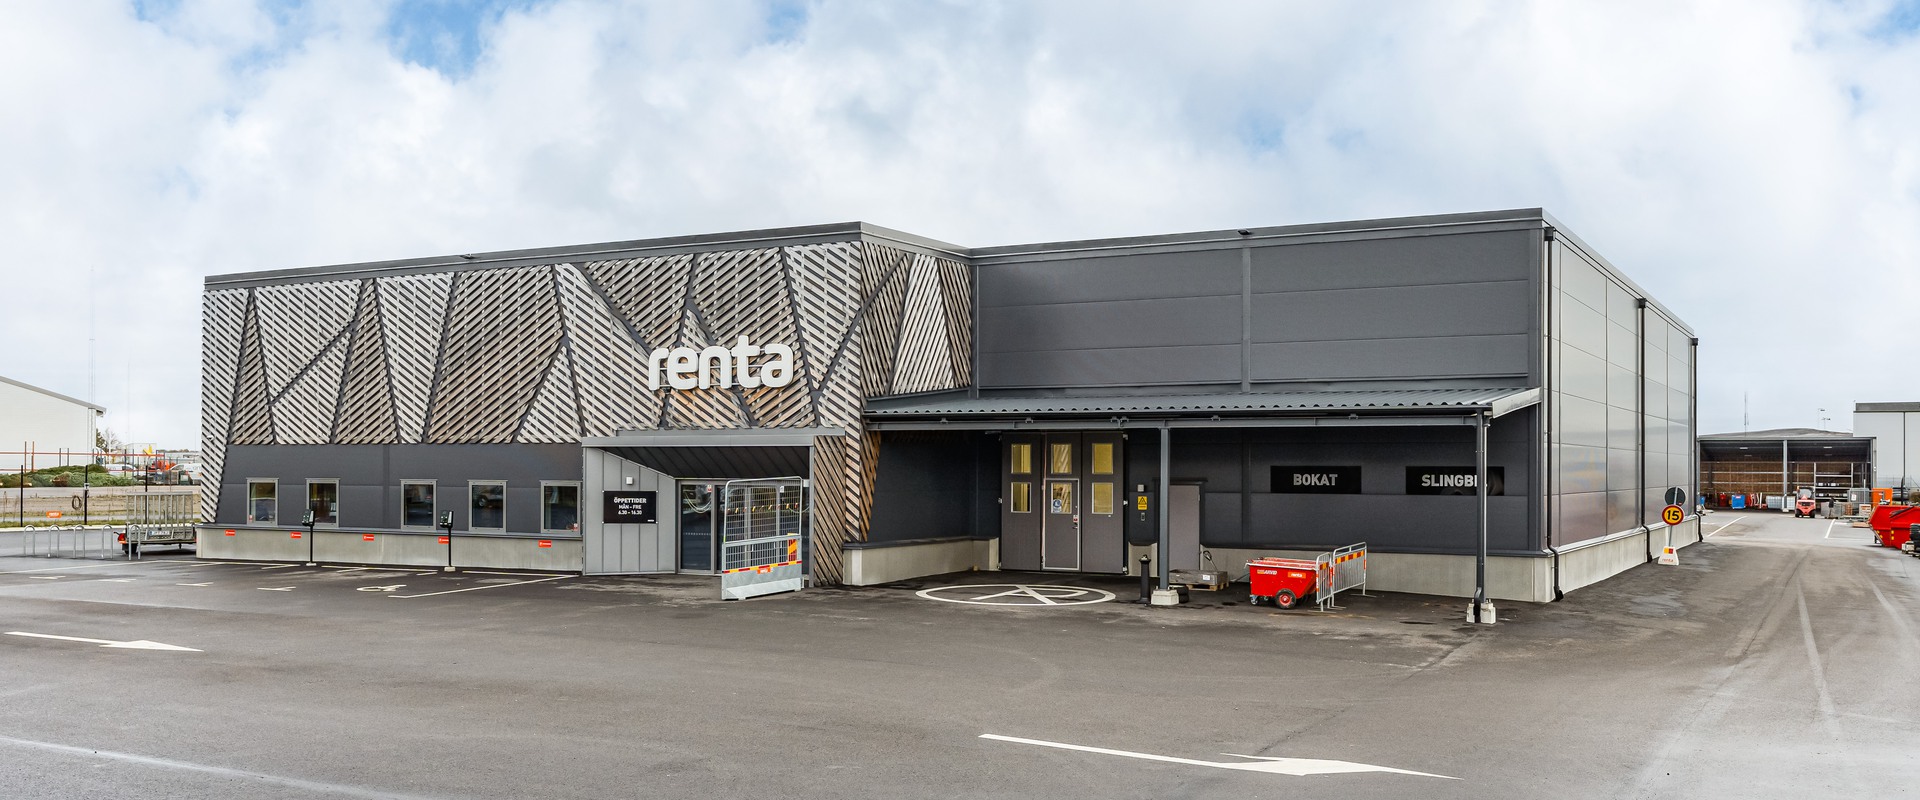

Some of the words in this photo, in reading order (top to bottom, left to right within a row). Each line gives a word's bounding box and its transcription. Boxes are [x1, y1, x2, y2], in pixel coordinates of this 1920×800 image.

[648, 335, 794, 391] renta
[1293, 473, 1338, 486] BOKAT
[1421, 474, 1487, 487] SLINGBI
[1667, 510, 1680, 521] 15
